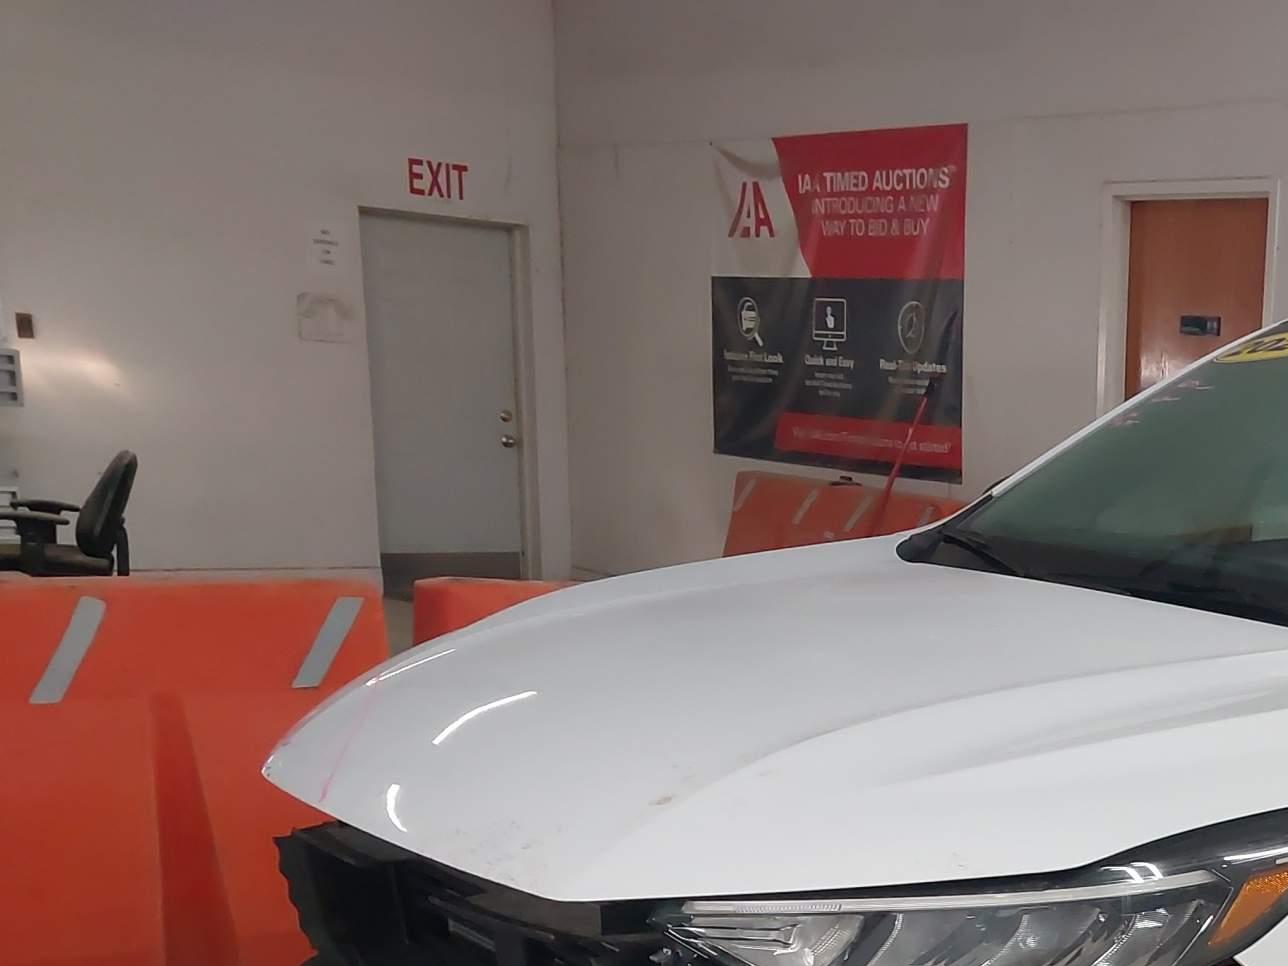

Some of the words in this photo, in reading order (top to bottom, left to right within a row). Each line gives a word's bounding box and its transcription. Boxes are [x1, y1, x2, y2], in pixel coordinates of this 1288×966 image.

[407, 157, 469, 201] EXIT
[798, 174, 820, 194] IAA
[822, 171, 868, 193] TIMED
[811, 195, 894, 215] INTRODUCING
[897, 196, 906, 213] A
[908, 194, 940, 213] NEW
[821, 219, 847, 237] WAY
[849, 218, 865, 237] TO
[867, 218, 888, 237] BID
[890, 219, 900, 236] &
[903, 217, 931, 236] BUY
[804, 354, 824, 366] Quick
[838, 356, 855, 370] Easy
[912, 360, 947, 374] Updates
